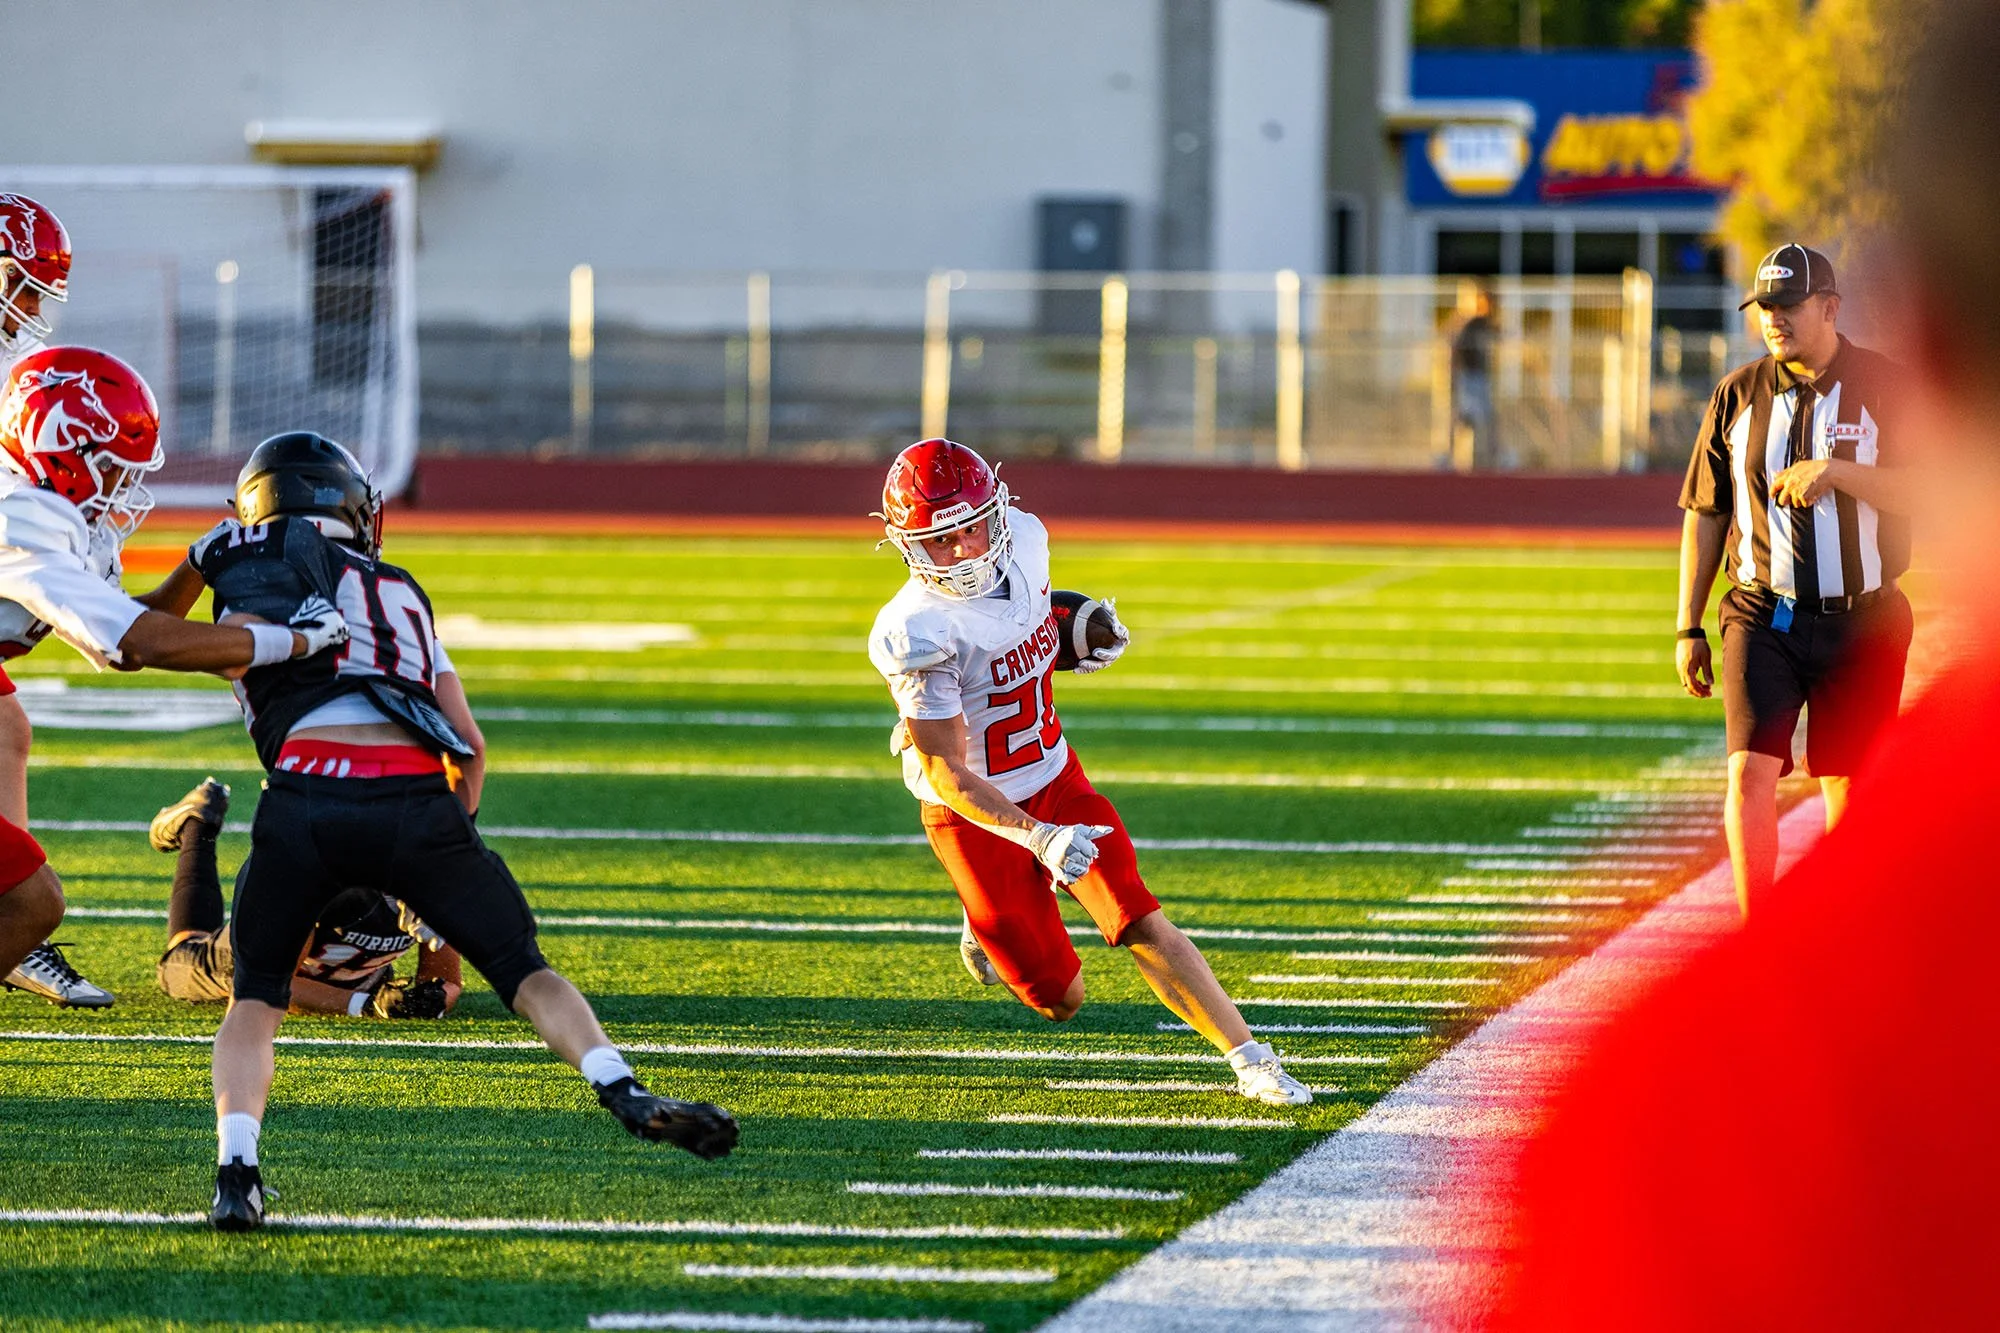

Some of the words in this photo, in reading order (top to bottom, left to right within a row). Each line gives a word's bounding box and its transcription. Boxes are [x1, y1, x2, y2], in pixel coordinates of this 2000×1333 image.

[936, 504, 968, 520] Riddell
[228, 522, 269, 549] 10
[333, 565, 436, 696] 10
